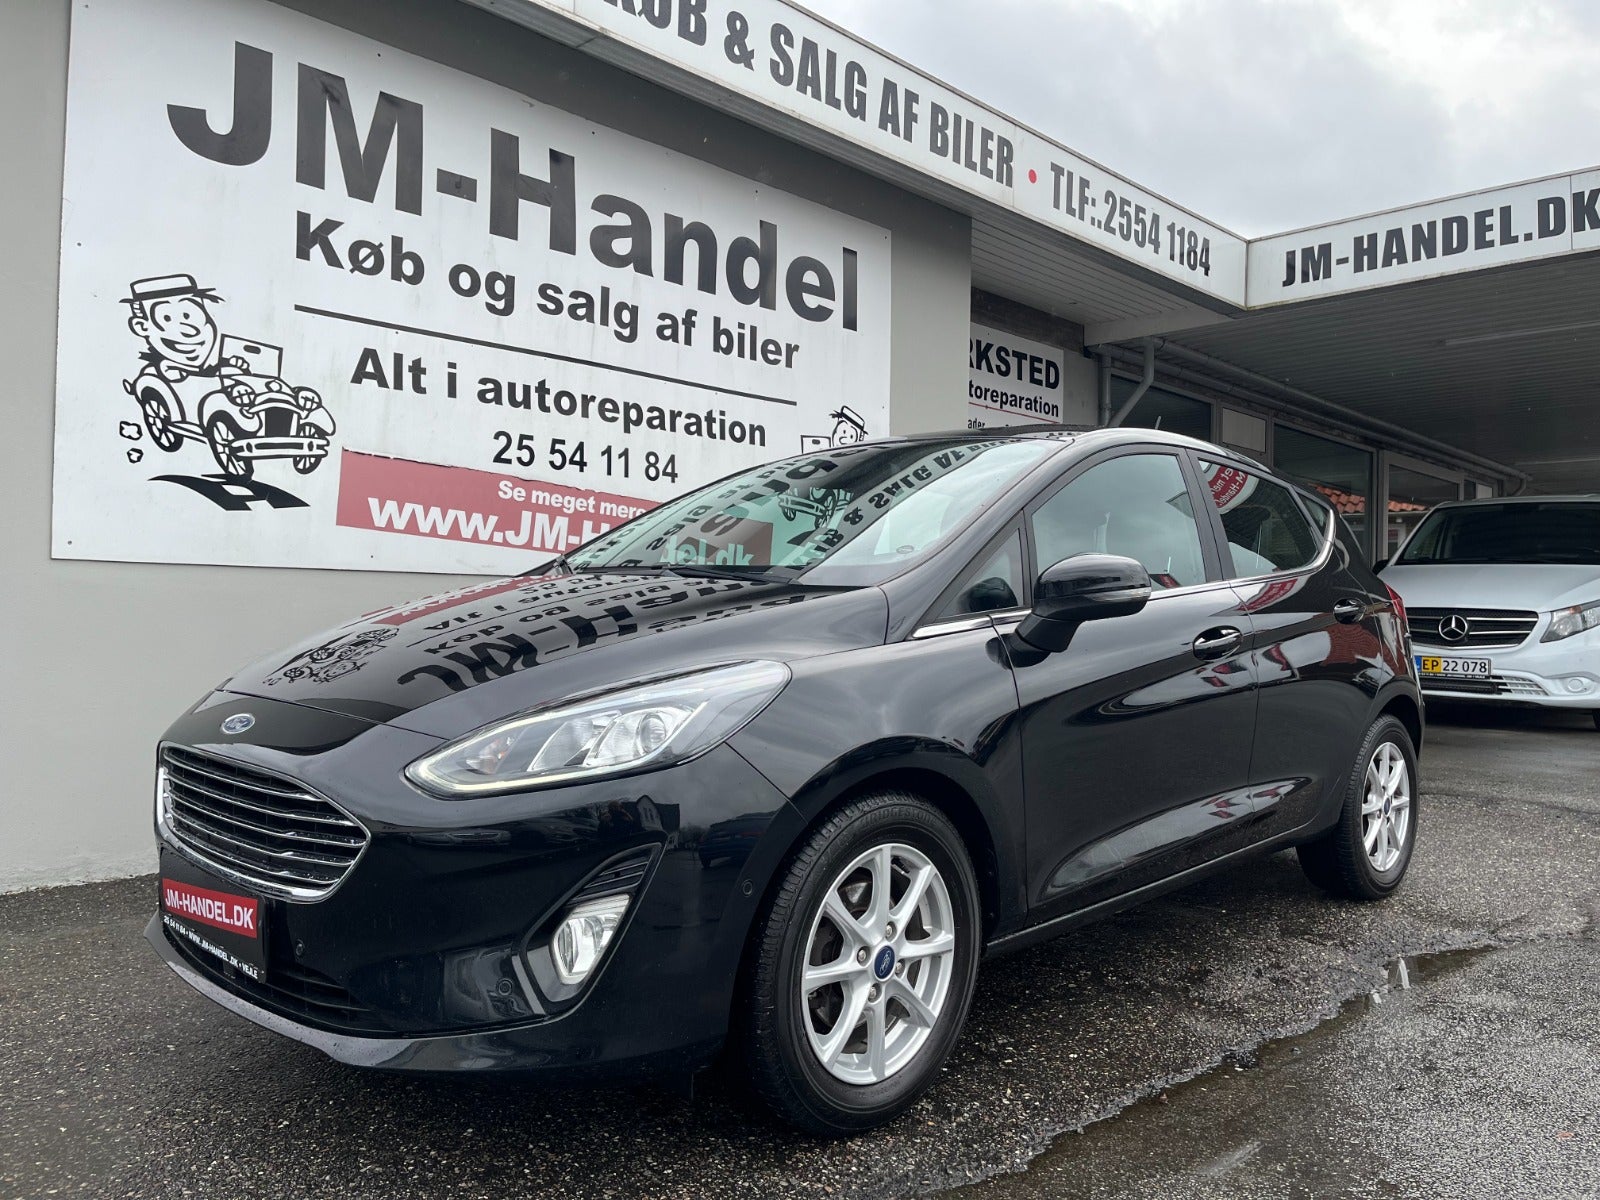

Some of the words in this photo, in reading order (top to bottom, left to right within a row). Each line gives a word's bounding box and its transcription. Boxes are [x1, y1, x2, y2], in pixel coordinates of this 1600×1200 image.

[166, 40, 858, 332] JM-Handel
[723, 10, 755, 72] &
[769, 22, 868, 123] SALG
[878, 77, 920, 144] AF
[929, 101, 1014, 188] BILER
[1166, 221, 1211, 277] 1184
[1281, 187, 1600, 288] JM-HANDEL.DK
[295, 210, 426, 287] Køb
[448, 262, 517, 317] og
[537, 281, 640, 344] salg
[655, 306, 697, 347] af
[713, 314, 801, 370] biler
[350, 347, 428, 399] Alt
[447, 361, 458, 400] i
[476, 376, 767, 449] autoreparation
[492, 430, 537, 467] 25
[549, 437, 588, 473] 54
[600, 444, 631, 480] 11
[644, 450, 680, 484] 84
[497, 480, 526, 502] Se
[531, 487, 596, 515] meget
[1422, 658, 1440, 671] EP
[1442, 659, 1459, 672] 22
[1461, 660, 1488, 674] 078
[165, 888, 254, 930] JM-HANDEL.DK
